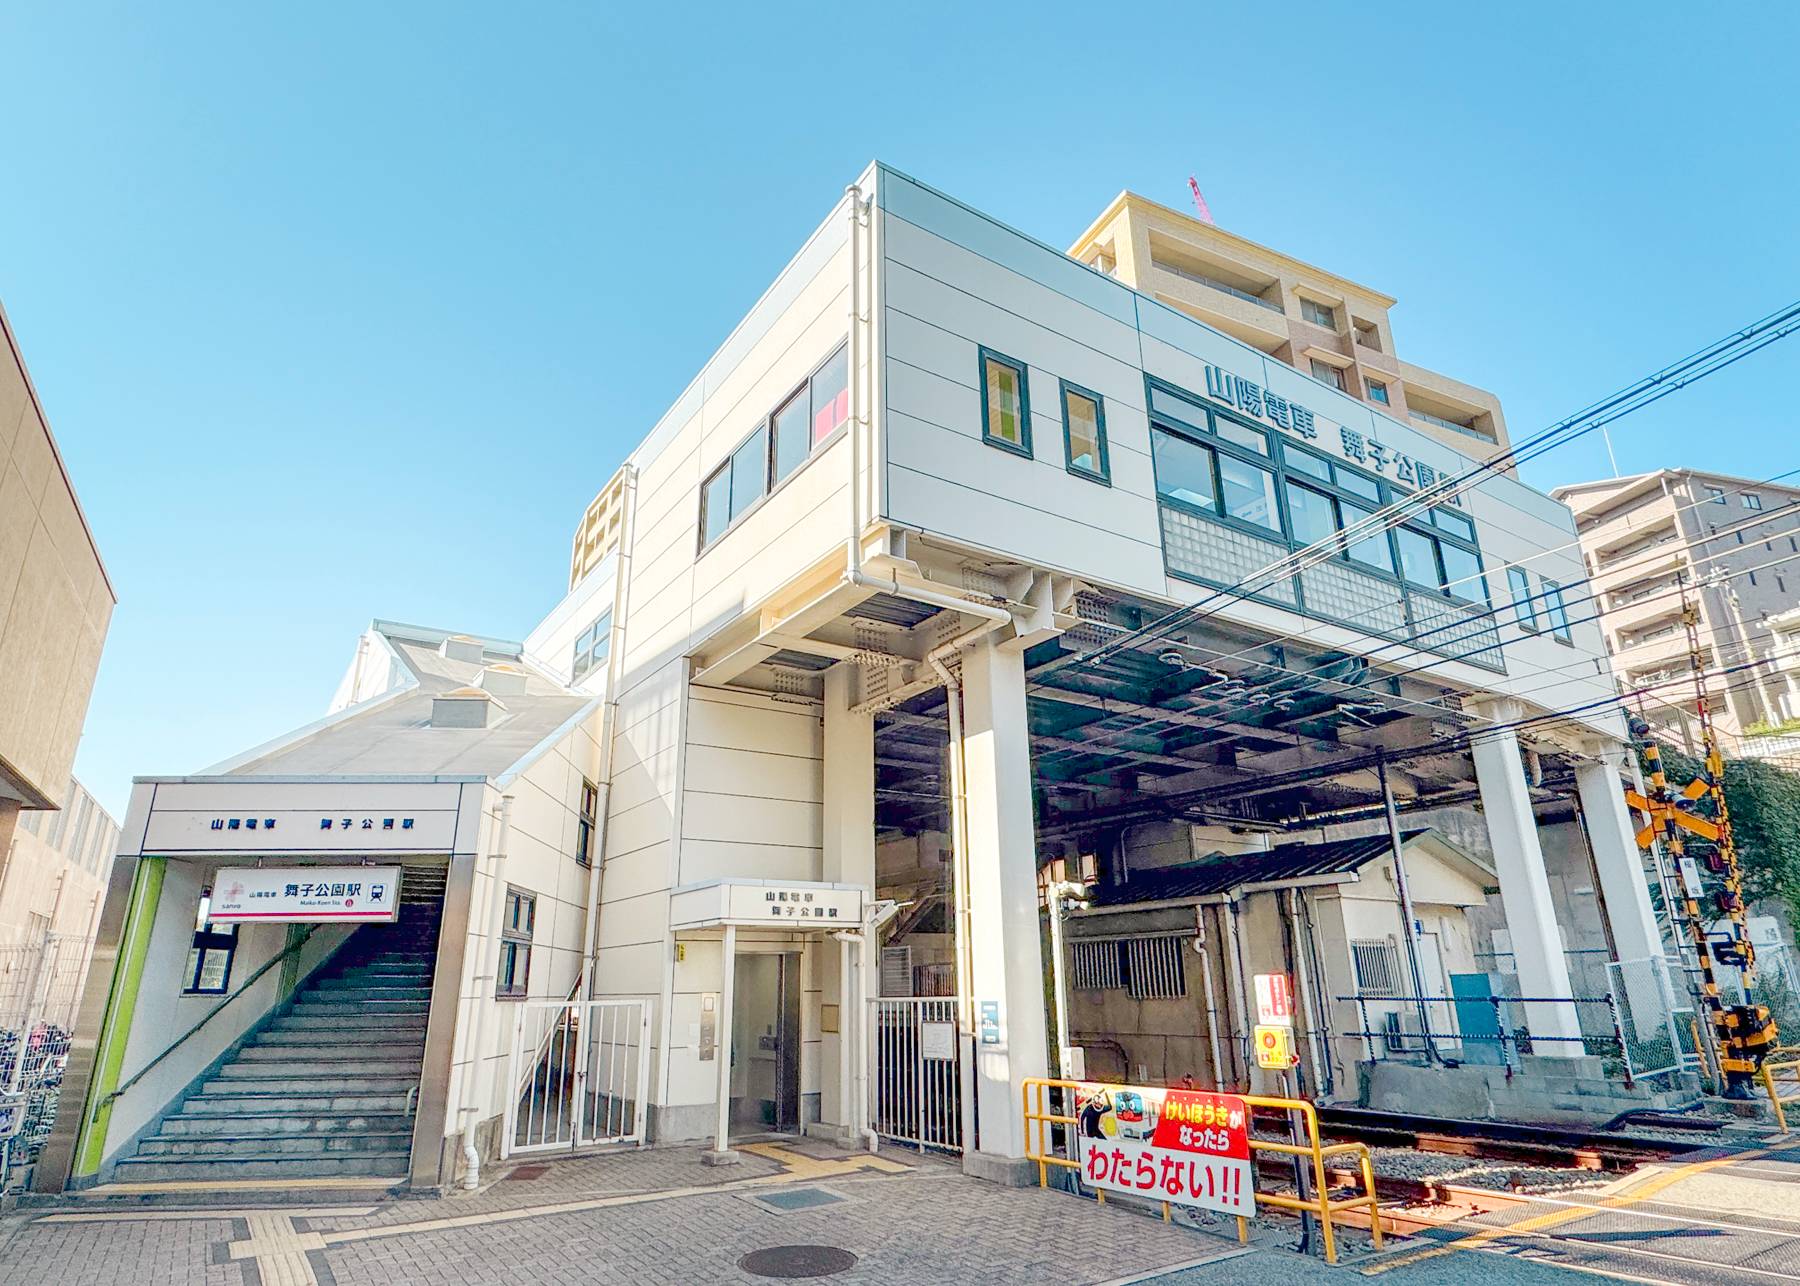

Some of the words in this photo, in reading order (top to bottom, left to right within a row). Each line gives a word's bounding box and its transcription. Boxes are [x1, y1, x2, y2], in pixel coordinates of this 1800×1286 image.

[1204, 365, 1318, 439] 山陽電車
[284, 883, 361, 897] 舞子公園駅
[1165, 1100, 1243, 1130] けいほうきが
[1179, 1124, 1231, 1151] なったら
